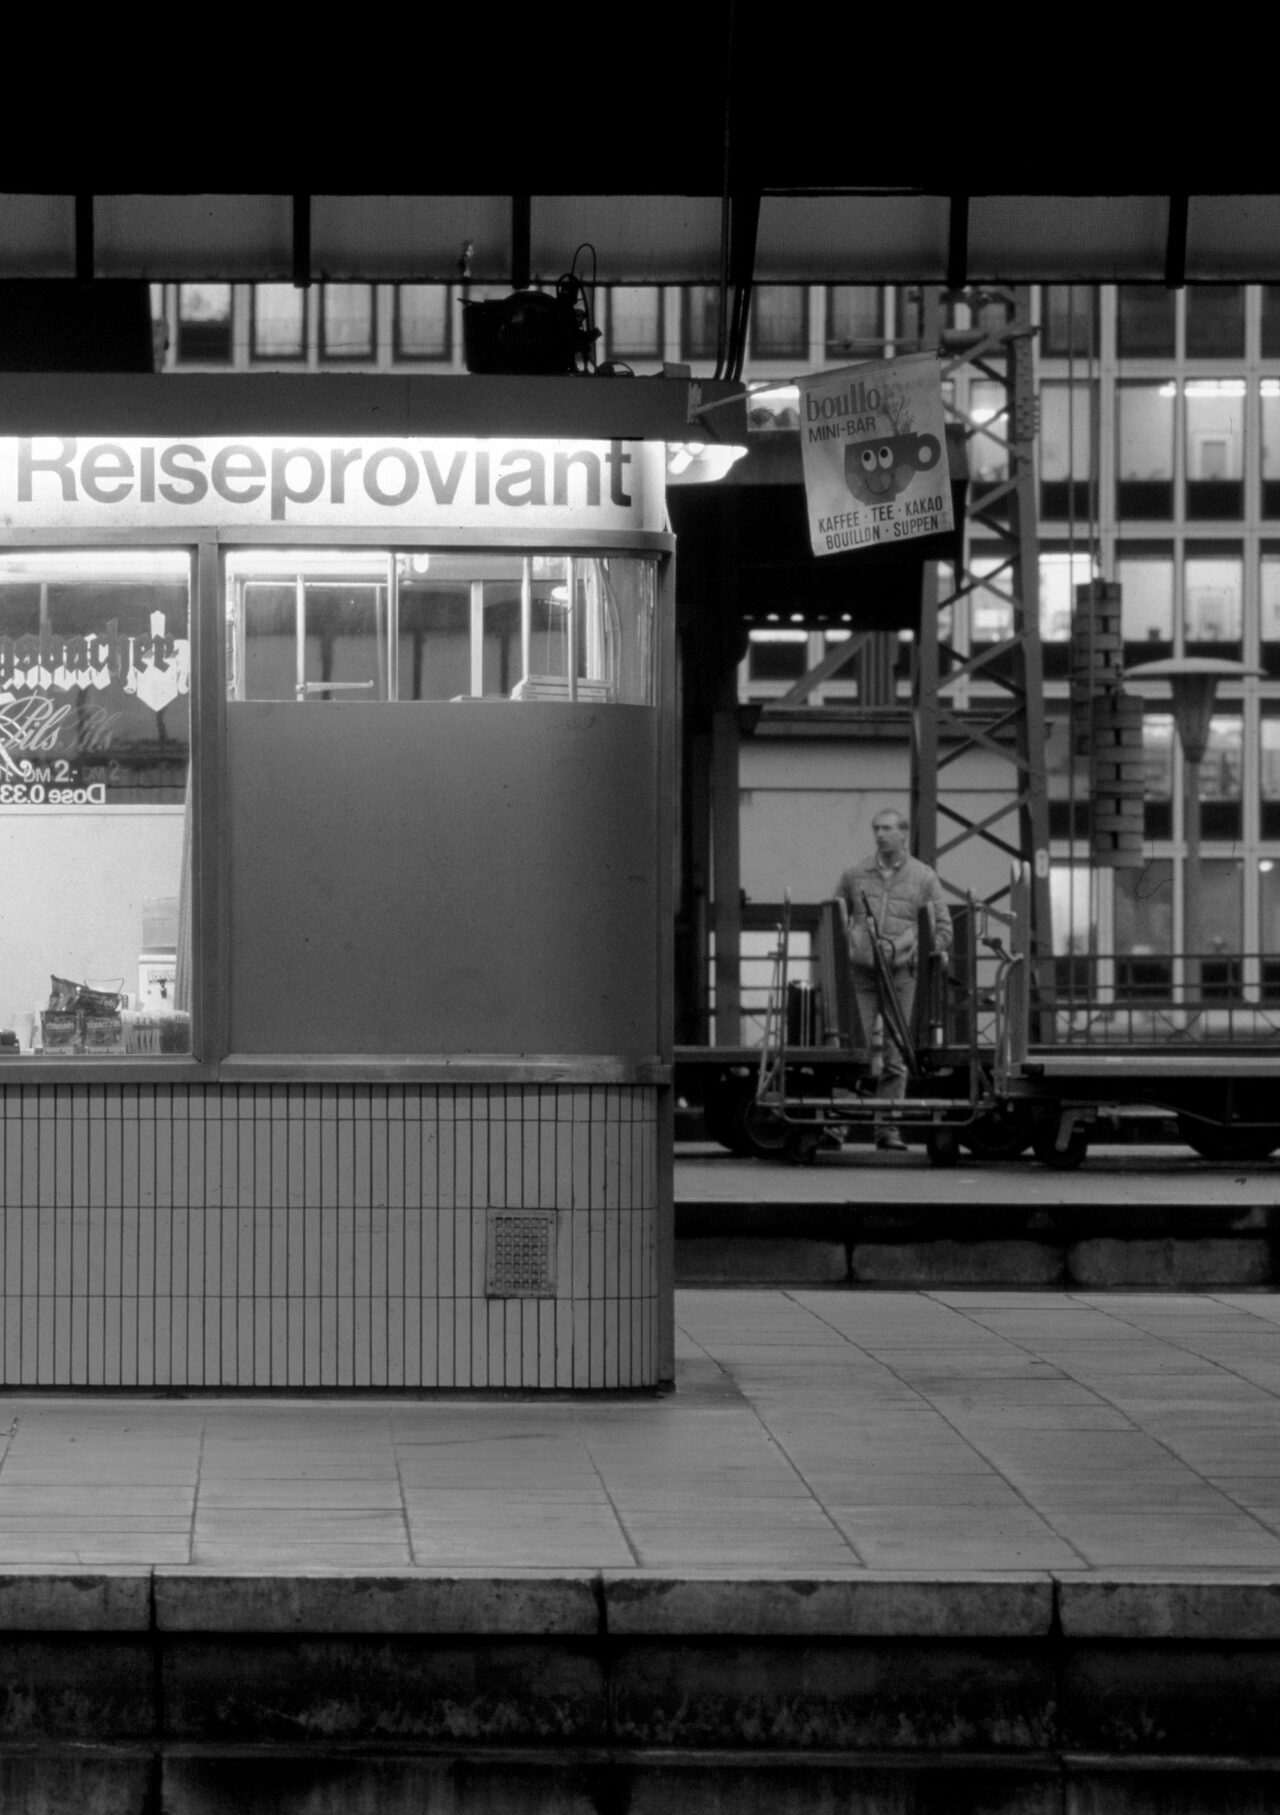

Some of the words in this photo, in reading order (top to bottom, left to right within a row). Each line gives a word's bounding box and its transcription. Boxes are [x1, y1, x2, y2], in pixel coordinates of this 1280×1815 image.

[809, 416, 876, 443] MINI-BAR
[17, 436, 632, 521] Reiseproviant
[819, 511, 860, 534] KAFFEE
[871, 504, 894, 522] TEE
[905, 496, 943, 517] KAKAO
[826, 525, 881, 550] BOUILLON
[893, 515, 939, 538] SUPPEN
